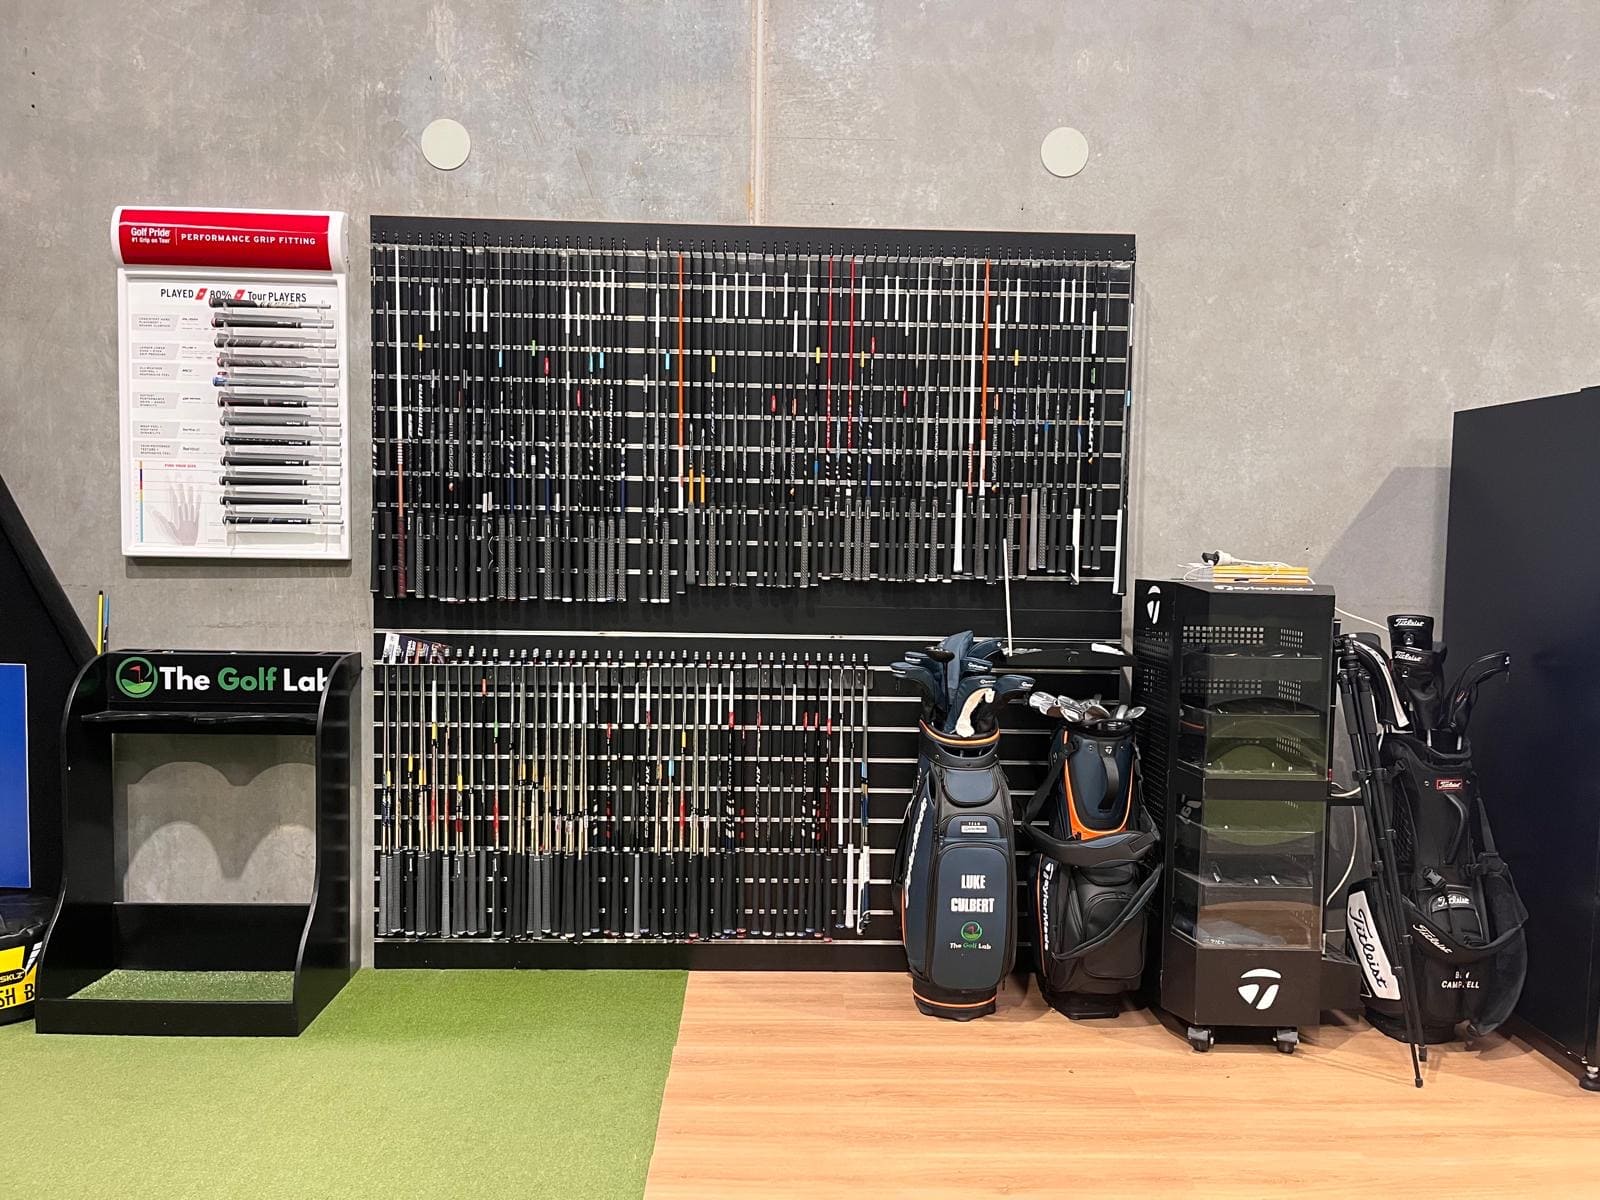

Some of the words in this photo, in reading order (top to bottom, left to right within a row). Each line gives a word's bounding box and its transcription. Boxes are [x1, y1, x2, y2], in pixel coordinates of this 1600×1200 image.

[131, 227, 147, 237] Golf
[148, 228, 171, 238] Pride
[181, 233, 251, 243] PERFORMANCE
[253, 234, 276, 244] GRIP
[278, 236, 316, 245] FITTING
[139, 237, 150, 245] Grip
[160, 288, 194, 299] PLAYED
[209, 290, 232, 300] 80%
[247, 291, 266, 301] Tour
[268, 292, 307, 303] PLAYERS
[1393, 618, 1425, 627] Titleist
[159, 665, 211, 691] The
[217, 667, 278, 691] Golf
[961, 874, 986, 889] LUKE
[950, 897, 995, 913] CULBERT
[1042, 863, 1055, 951] TaylorMade
[949, 942, 962, 950] The
[962, 942, 977, 950] Golf
[978, 942, 992, 950] Lab
[1412, 923, 1453, 954] Titleist
[1347, 908, 1388, 989] Titleist
[1441, 980, 1480, 989] CAMPELL
